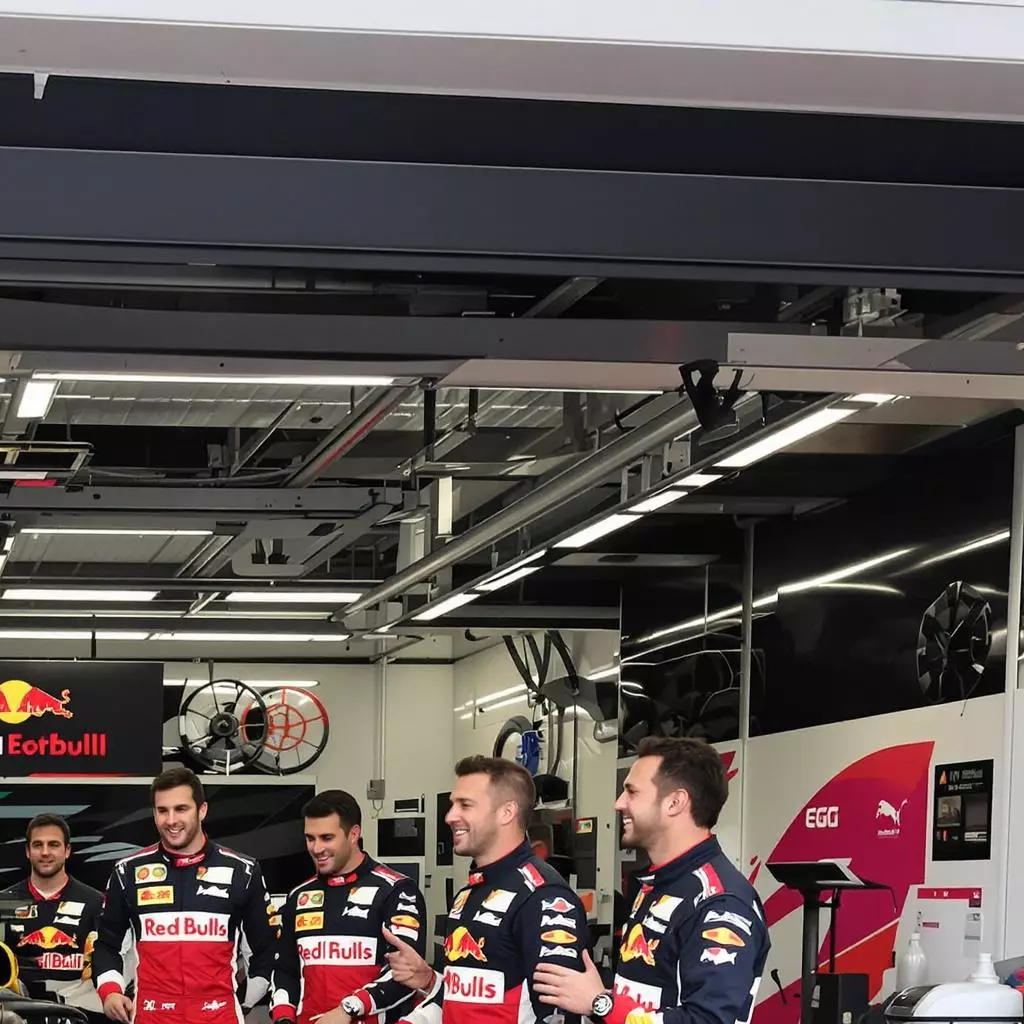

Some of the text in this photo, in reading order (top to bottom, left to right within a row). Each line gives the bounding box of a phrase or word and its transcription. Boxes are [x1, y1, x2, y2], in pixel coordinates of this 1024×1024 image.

[805, 806, 839, 828] EGG
[145, 917, 226, 936] Red Bulls
